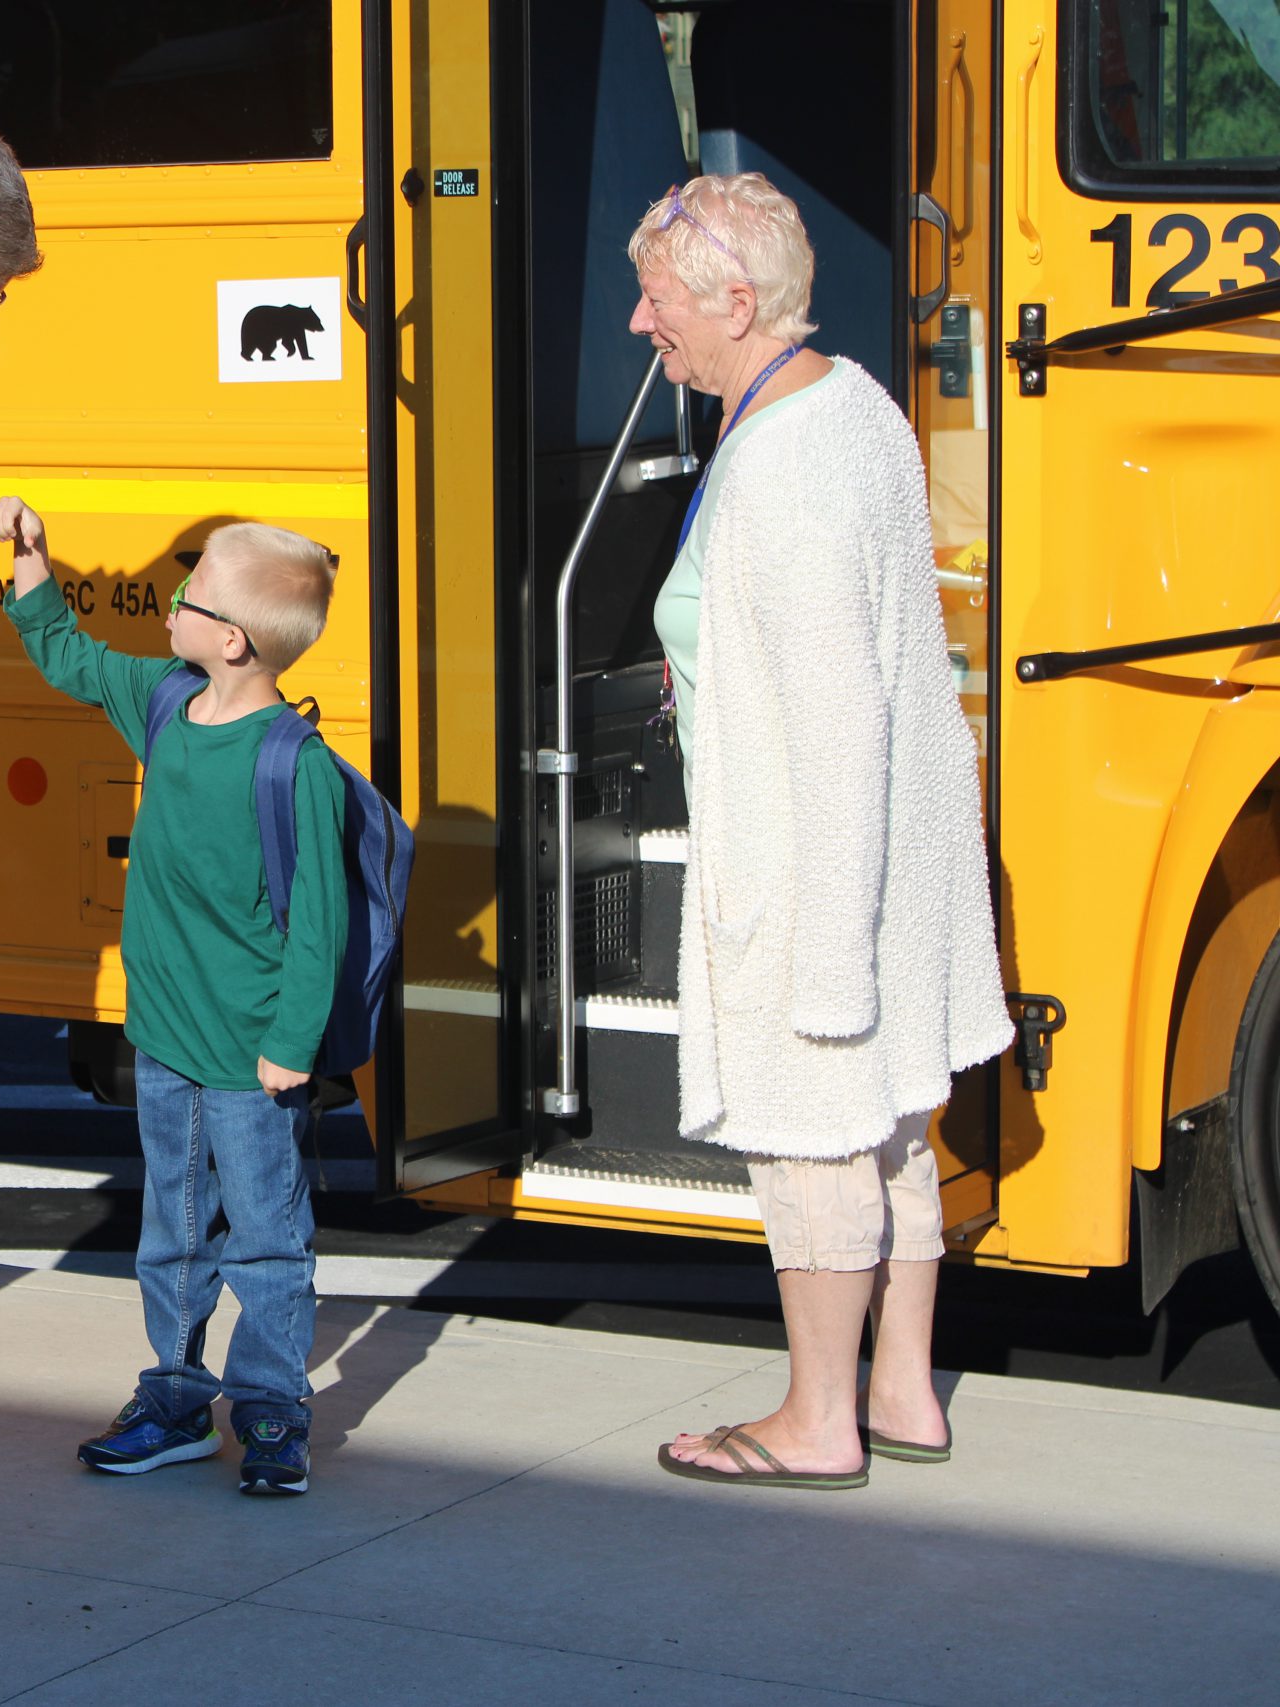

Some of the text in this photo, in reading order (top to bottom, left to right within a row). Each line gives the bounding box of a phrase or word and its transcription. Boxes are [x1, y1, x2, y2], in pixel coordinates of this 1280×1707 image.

[442, 171, 463, 183] DOOR
[443, 183, 475, 195] RELEASE
[1090, 212, 1280, 308] 123
[110, 581, 160, 617] 45A
